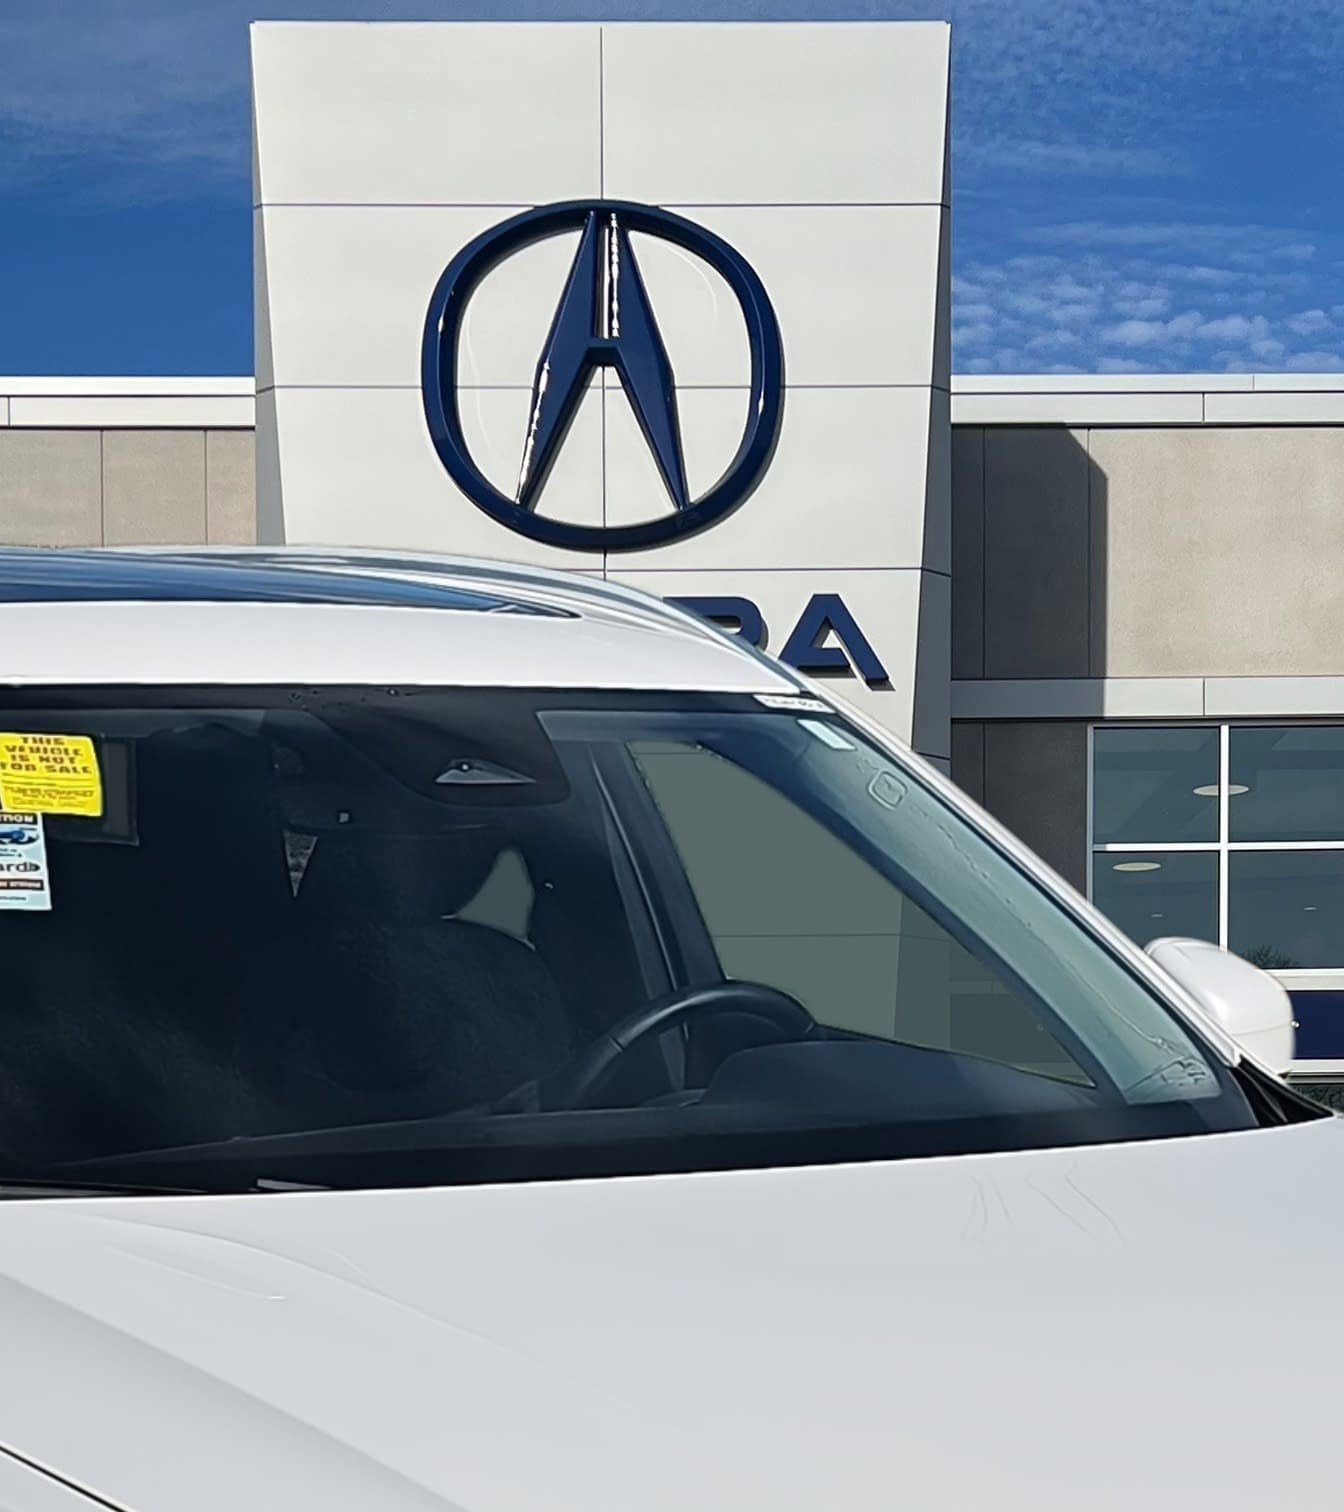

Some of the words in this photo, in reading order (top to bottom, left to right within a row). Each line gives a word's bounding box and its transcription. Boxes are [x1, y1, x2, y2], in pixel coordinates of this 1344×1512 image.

[10, 754, 30, 762] IS
[38, 756, 76, 764] NOT
[44, 765, 92, 774] SALE
